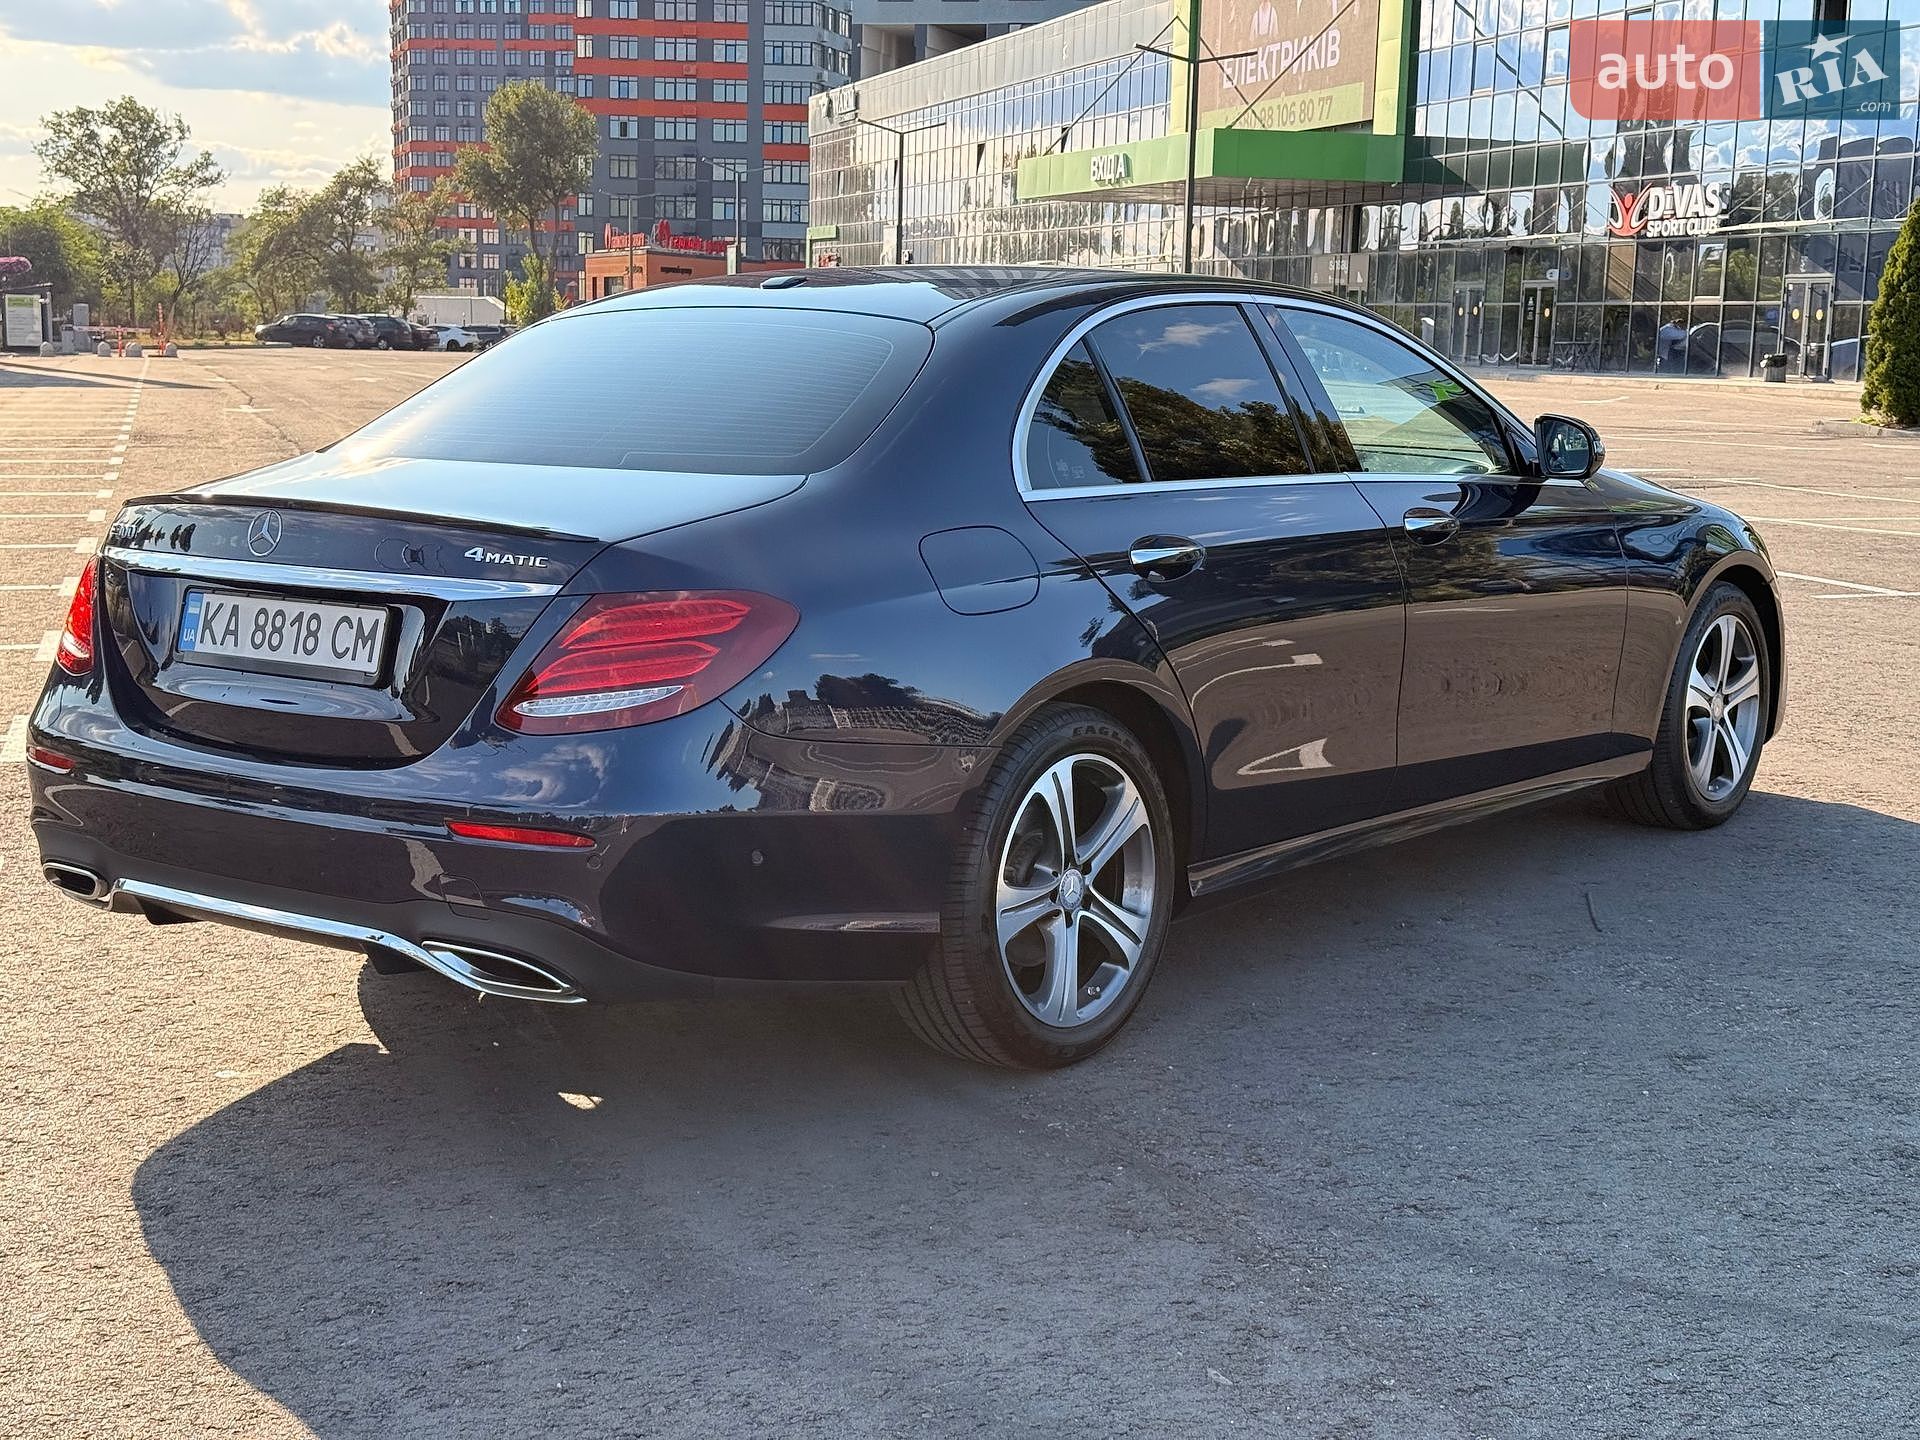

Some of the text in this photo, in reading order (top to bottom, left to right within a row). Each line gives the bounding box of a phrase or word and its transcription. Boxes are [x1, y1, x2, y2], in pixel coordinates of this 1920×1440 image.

[1223, 28, 1340, 89] ЕЛЕКТРИКІВ
[1277, 102, 1297, 127] 106
[1299, 98, 1315, 123] 80
[1317, 96, 1333, 121] 77
[1646, 216, 1718, 237] SPORT CLUB
[464, 546, 549, 568] 4MATIC
[183, 629, 196, 643] UA
[200, 601, 380, 663] KA 8818 CM
